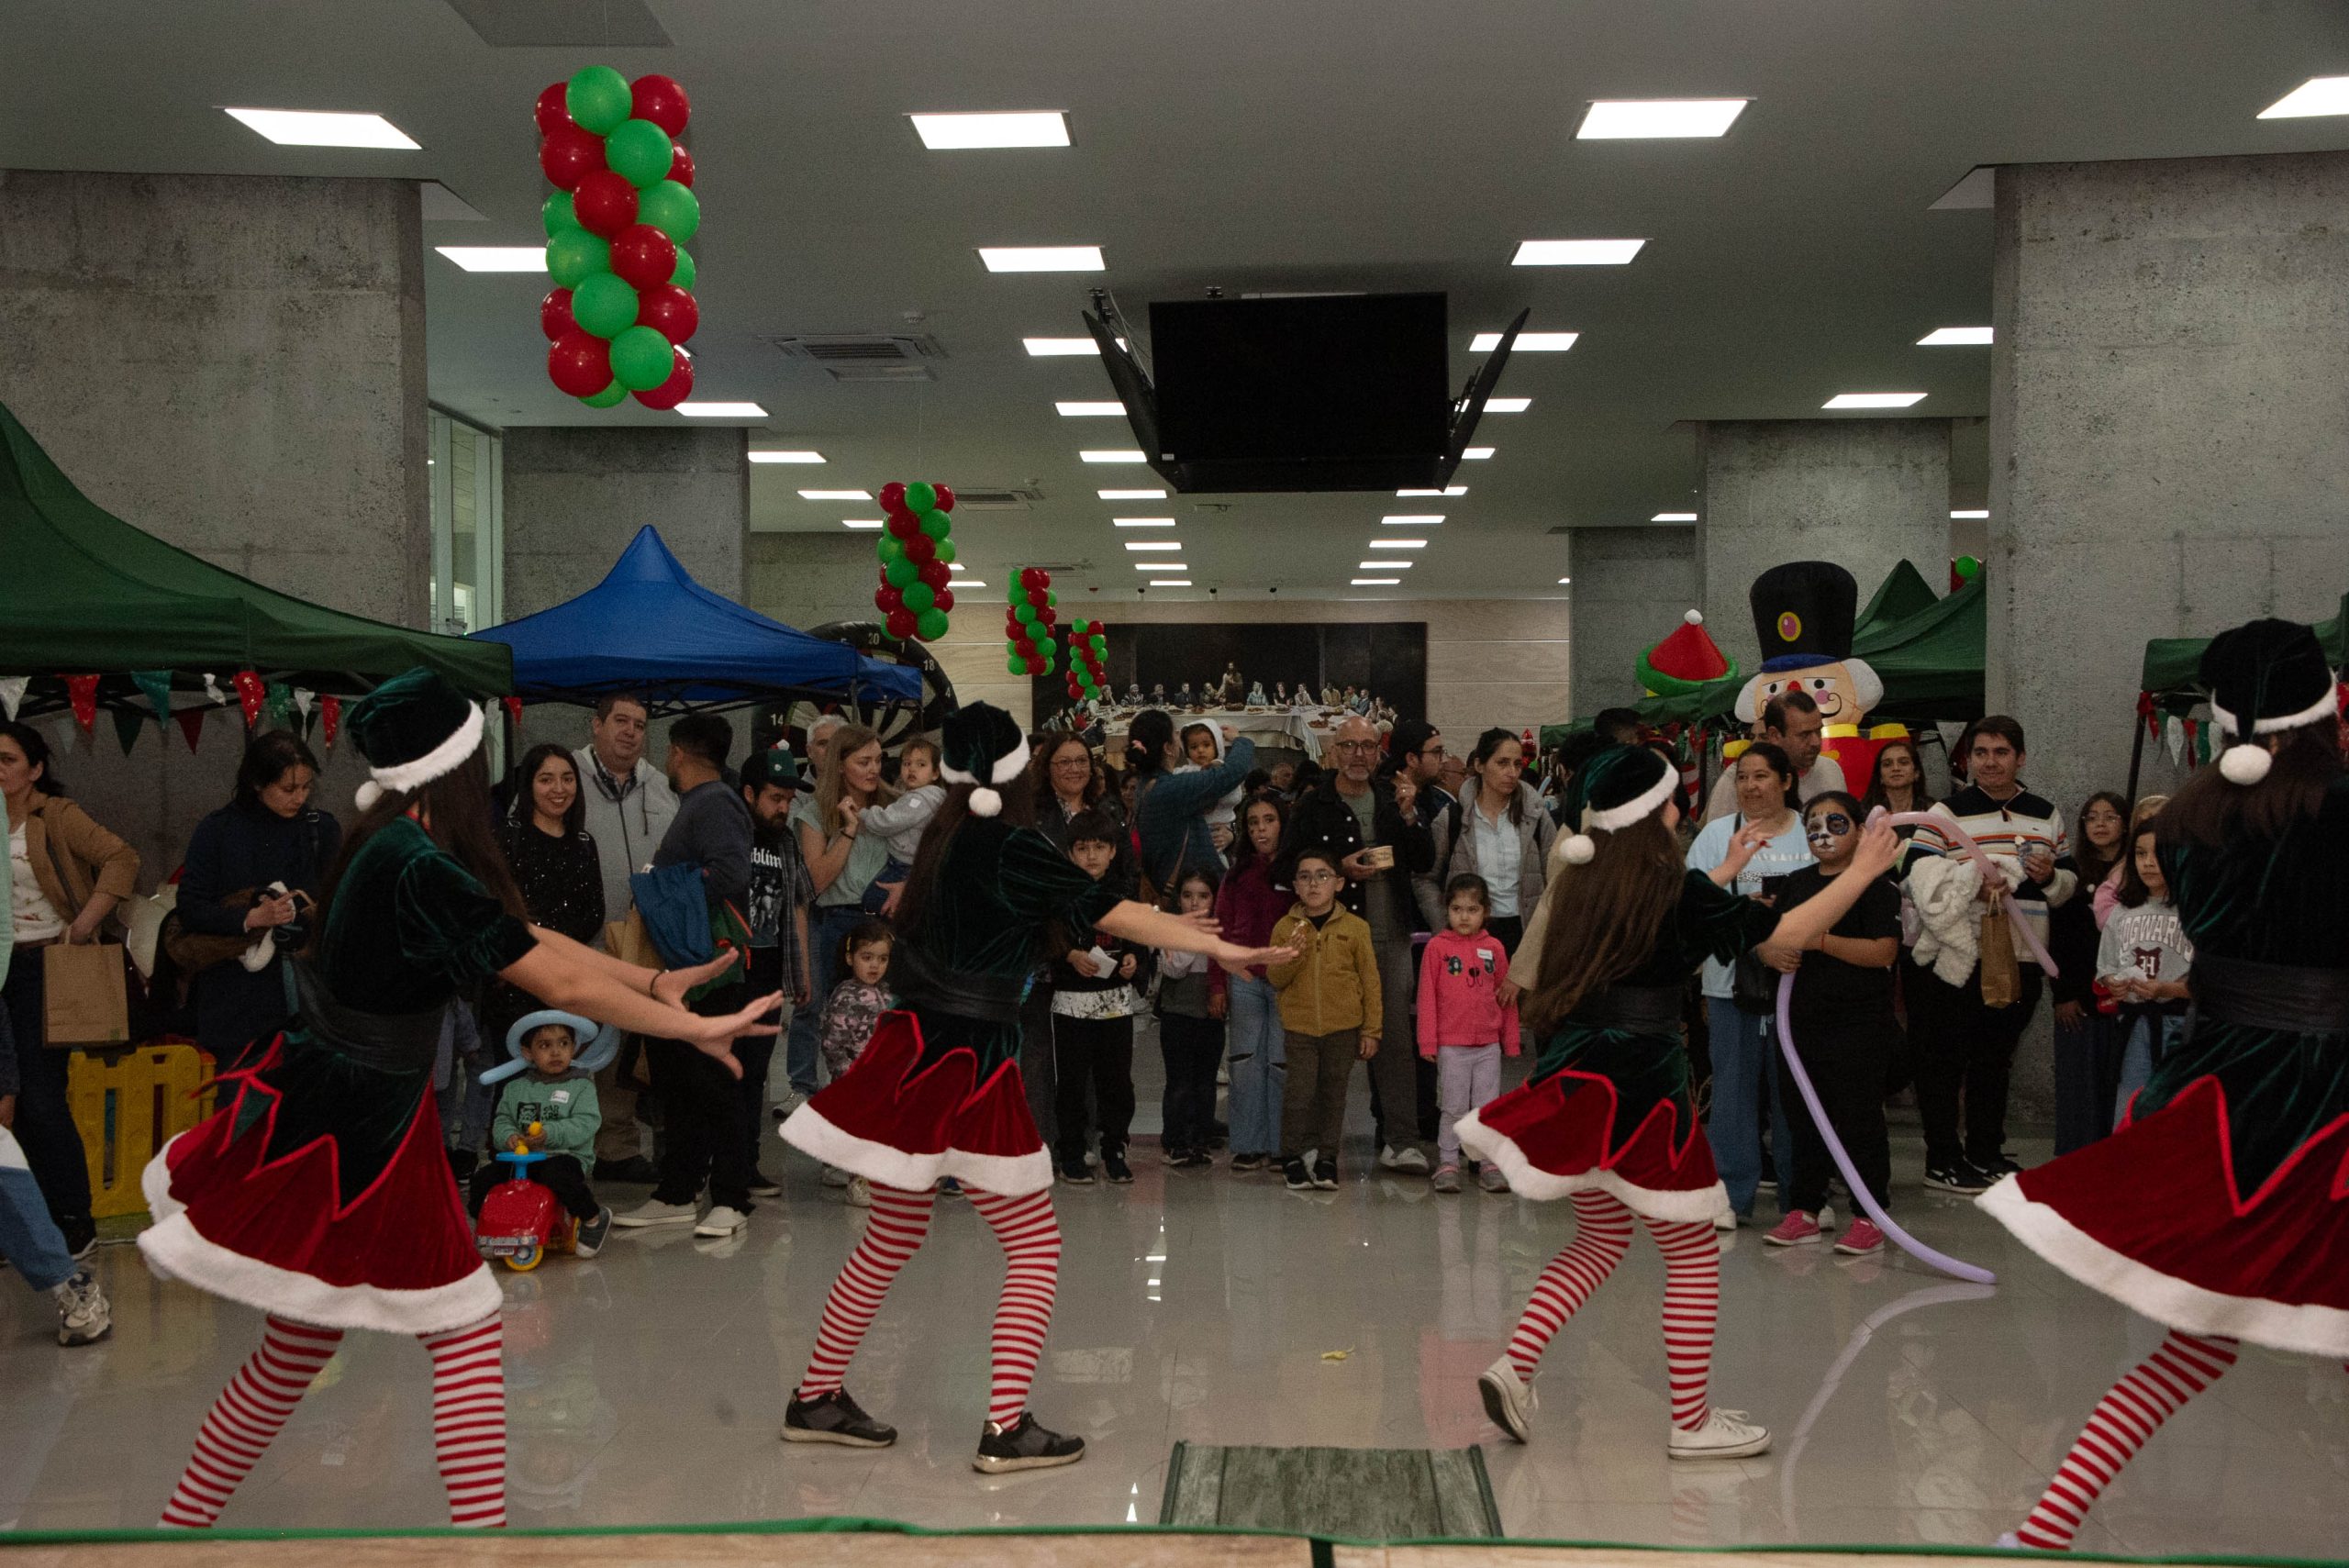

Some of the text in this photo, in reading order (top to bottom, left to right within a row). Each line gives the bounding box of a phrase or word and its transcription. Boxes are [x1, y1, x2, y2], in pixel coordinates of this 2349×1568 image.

[868, 632, 880, 645] 20
[900, 640, 906, 653] 1
[923, 659, 935, 671] 18
[945, 686, 951, 697] 4
[771, 713, 784, 726] 14
